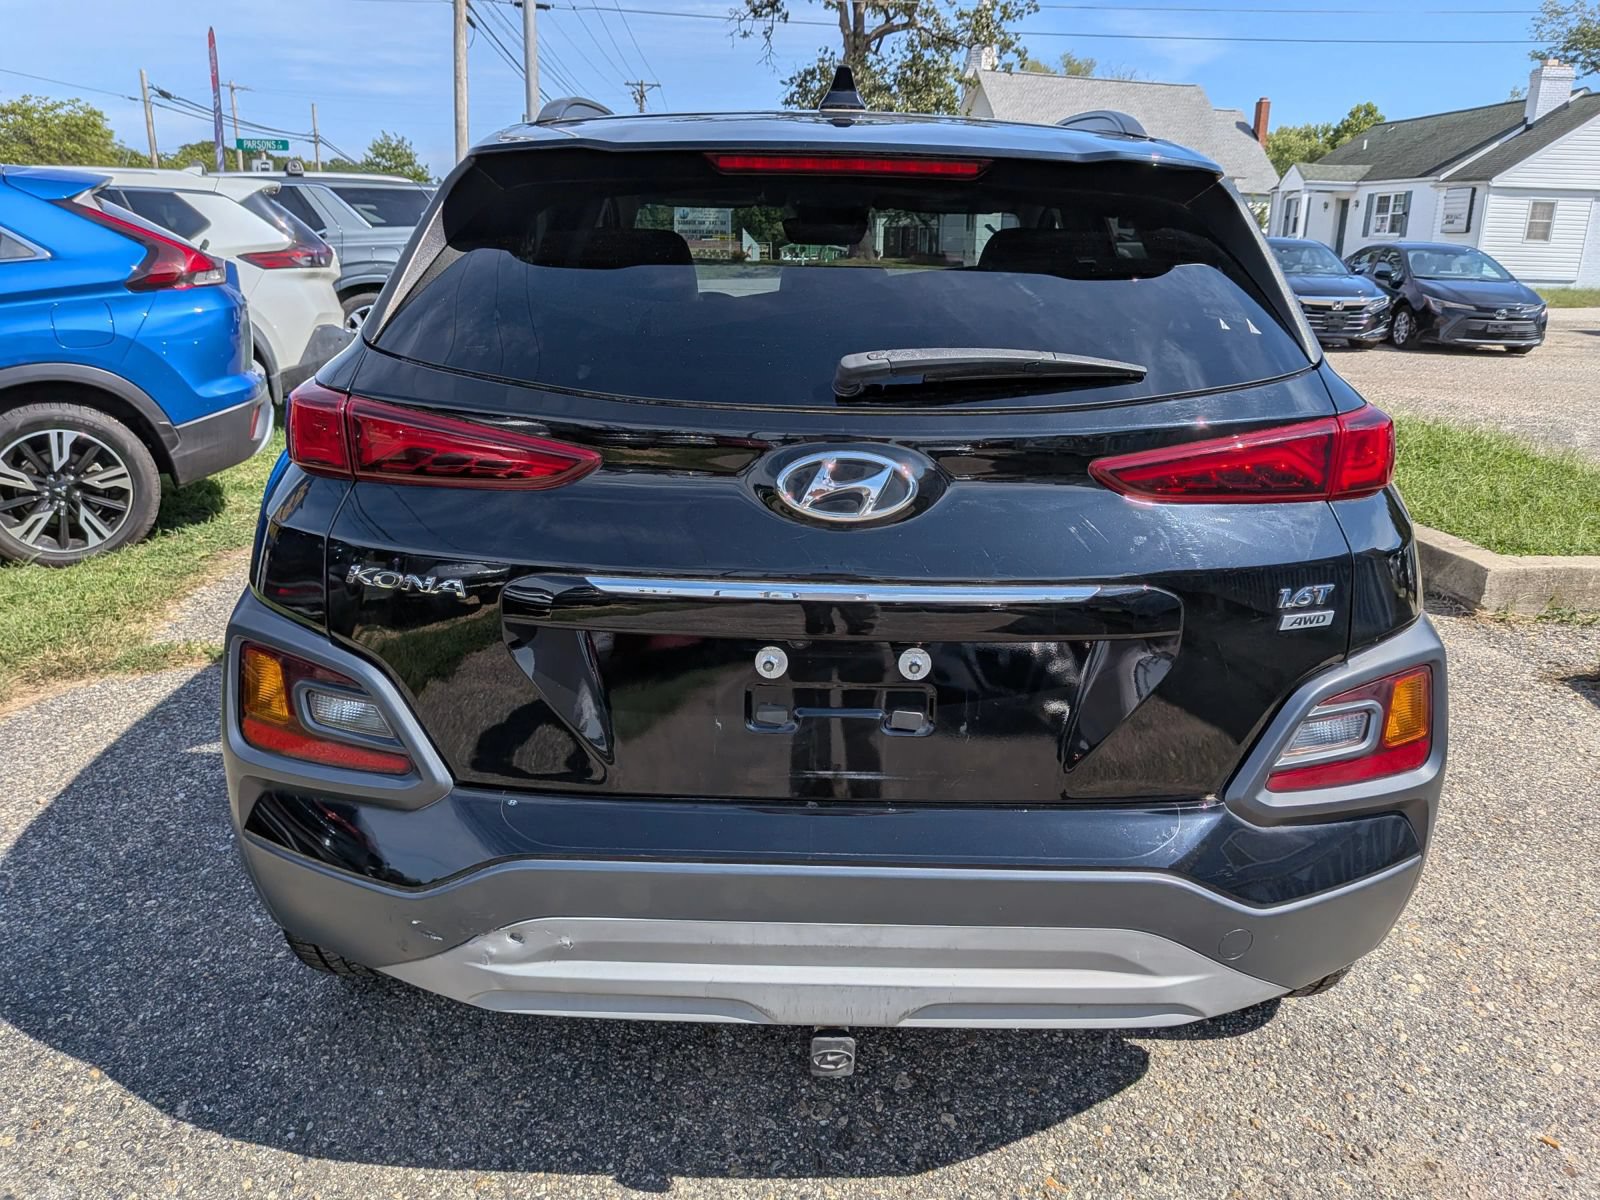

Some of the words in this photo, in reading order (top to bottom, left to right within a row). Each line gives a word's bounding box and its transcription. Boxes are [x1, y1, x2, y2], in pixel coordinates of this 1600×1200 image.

[243, 139, 276, 150] PARSONS
[345, 565, 466, 599] KONA
[1276, 583, 1336, 609] 1.6T
[1289, 614, 1327, 627] AWD
